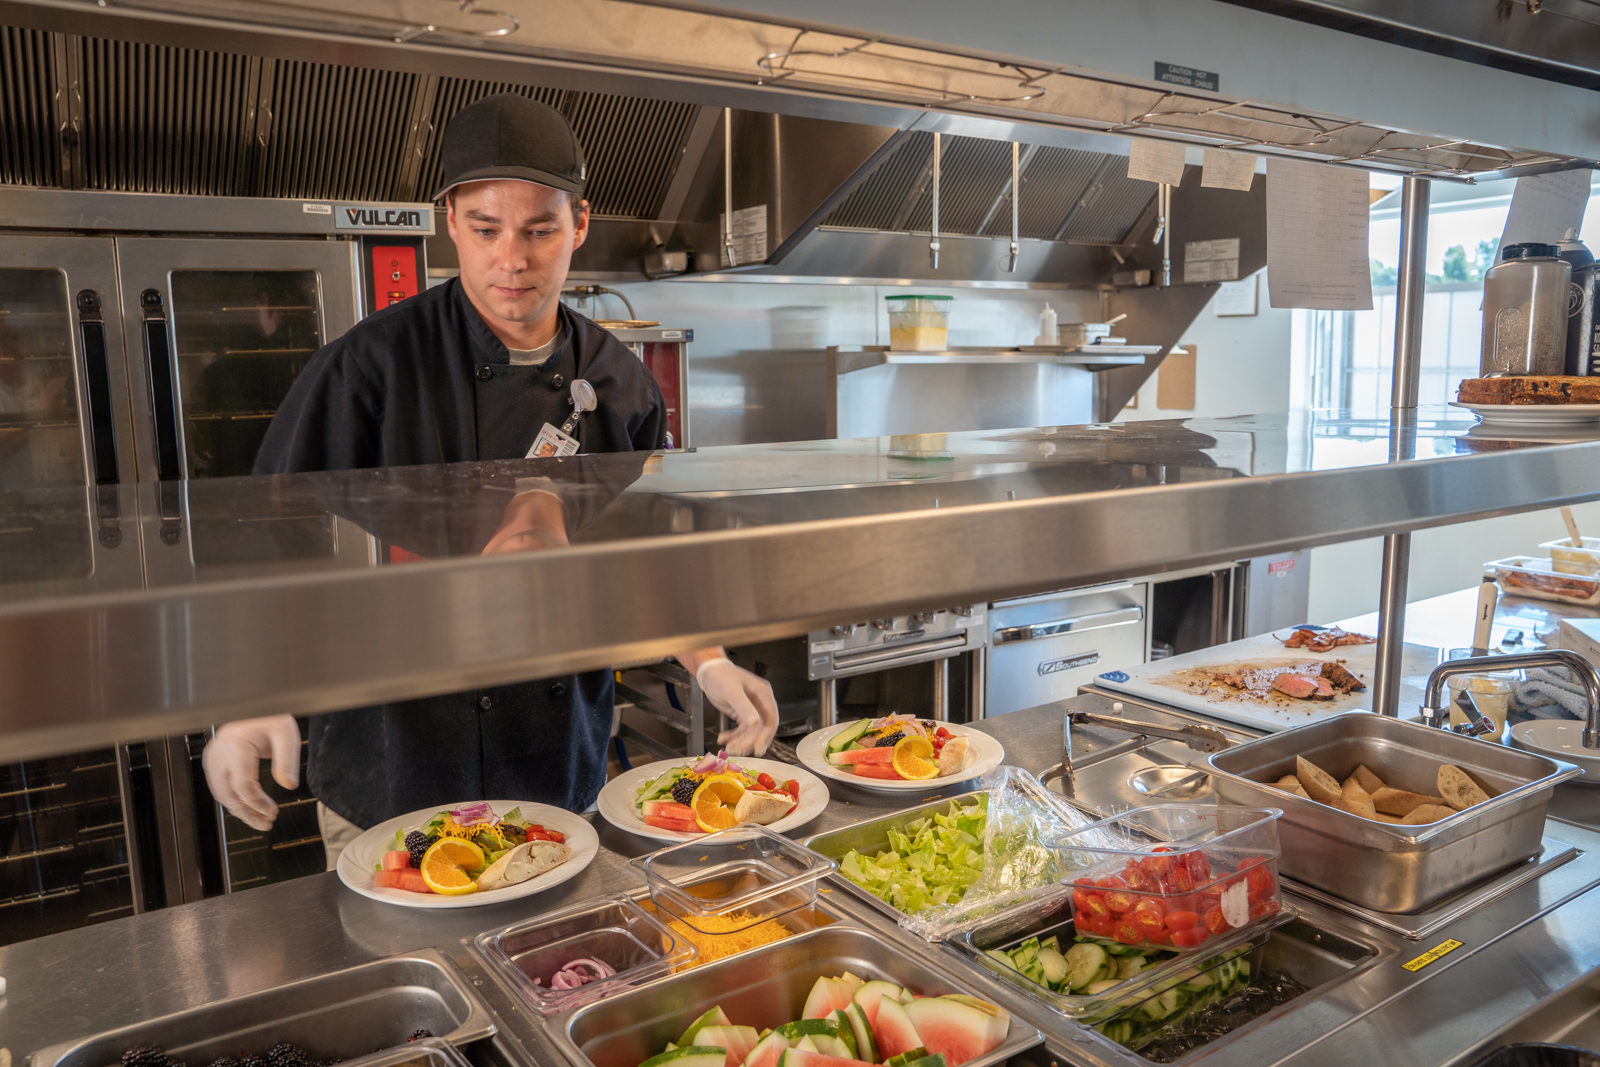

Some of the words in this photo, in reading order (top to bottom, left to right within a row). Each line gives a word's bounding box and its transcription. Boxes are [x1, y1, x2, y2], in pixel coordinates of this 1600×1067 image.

[1168, 66, 1192, 76] CAUTION
[1196, 71, 1207, 79] HOT
[1162, 73, 1191, 85] ATTENTION
[1195, 79, 1213, 89] CHAUD
[345, 208, 421, 227] VULCAN
